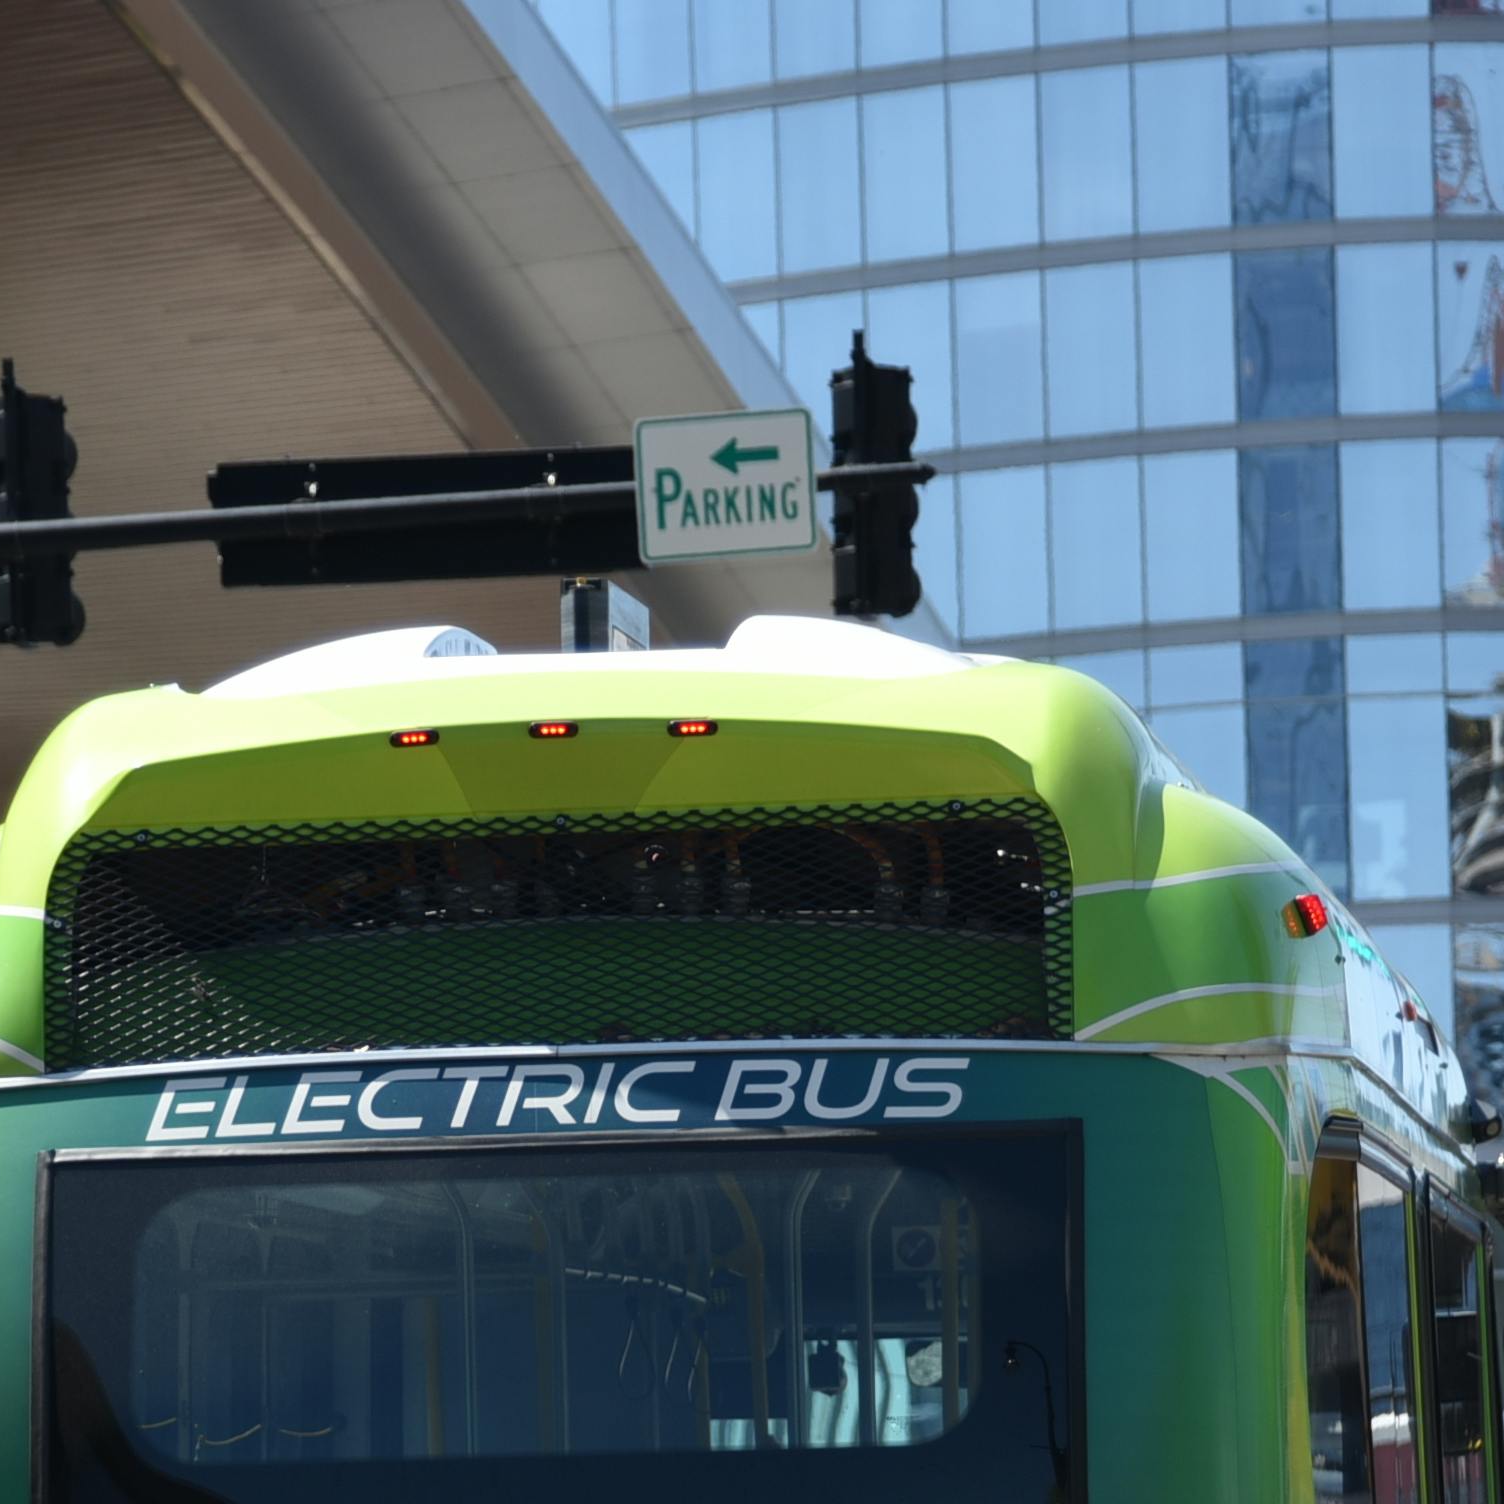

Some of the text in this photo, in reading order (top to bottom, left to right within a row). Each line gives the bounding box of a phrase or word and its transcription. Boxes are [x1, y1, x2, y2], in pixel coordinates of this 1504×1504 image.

[655, 466, 799, 531] PARKING
[145, 1057, 971, 1141] ELECTRIC BUS
